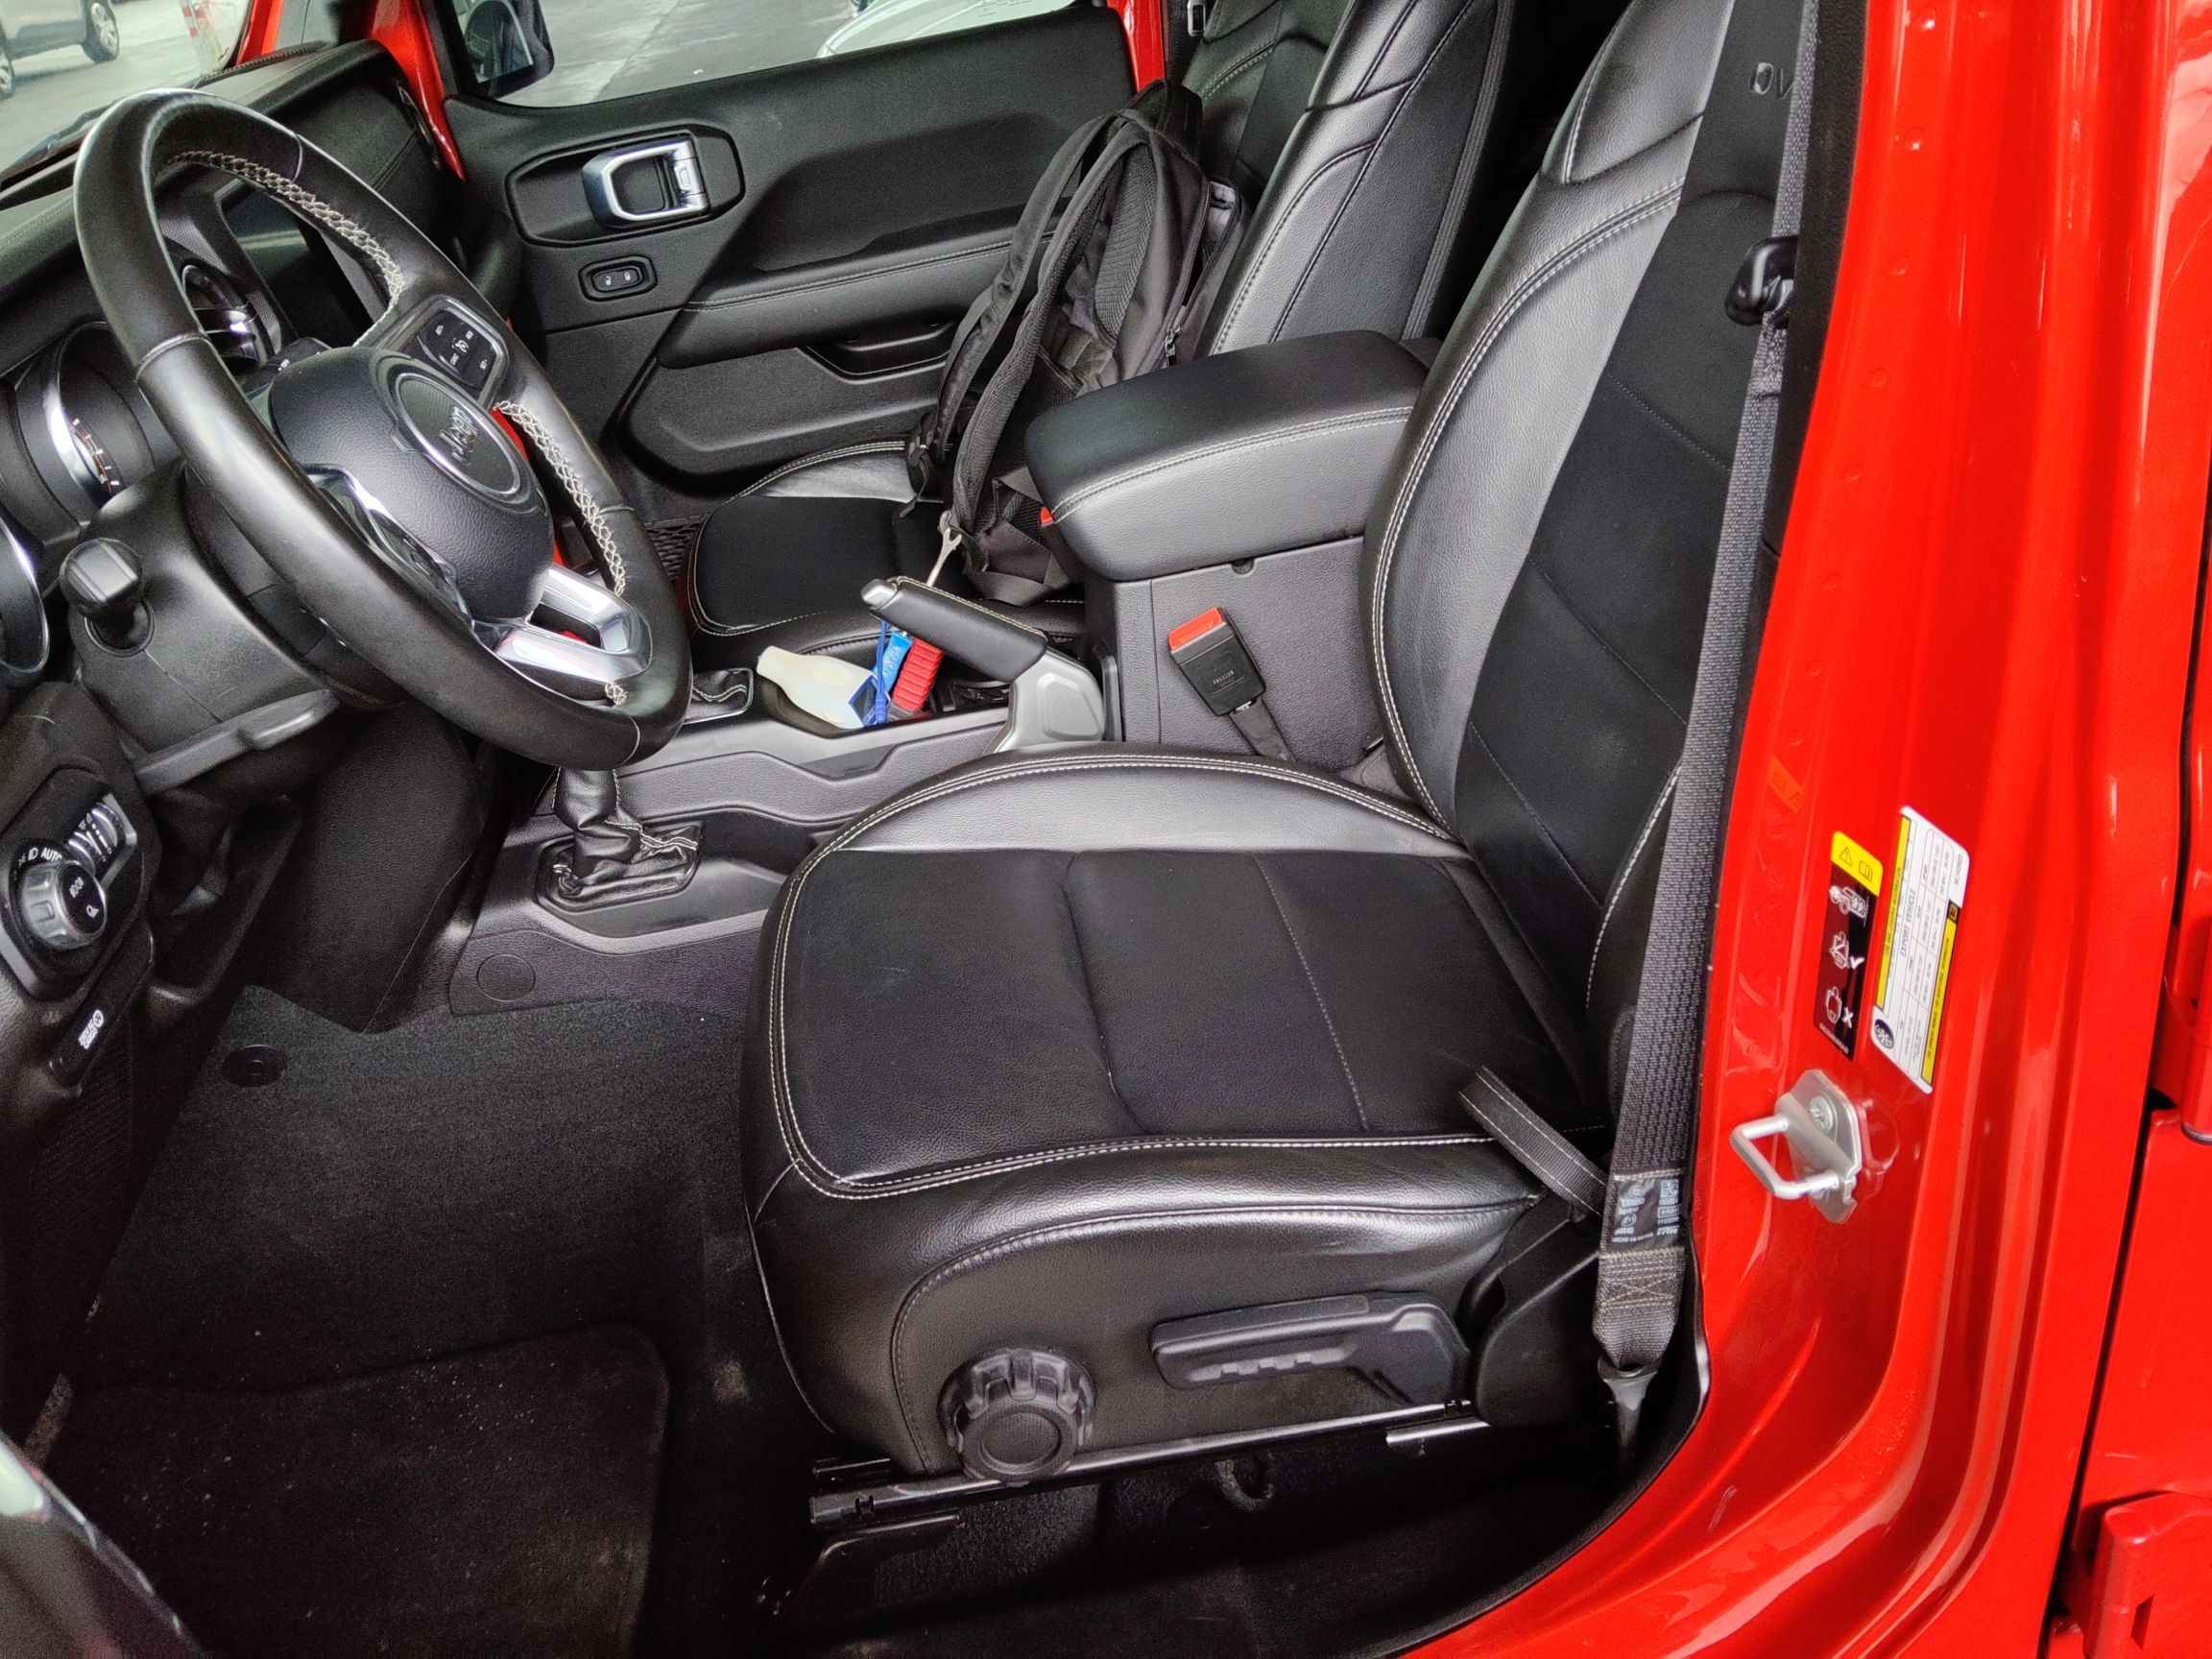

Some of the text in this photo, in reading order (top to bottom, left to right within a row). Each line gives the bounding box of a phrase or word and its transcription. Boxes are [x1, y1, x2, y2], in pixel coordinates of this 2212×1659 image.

[439, 406, 478, 463] Jeep
[1905, 886, 1915, 924] VEHICLE
[1900, 923, 1911, 958] EXPORT
